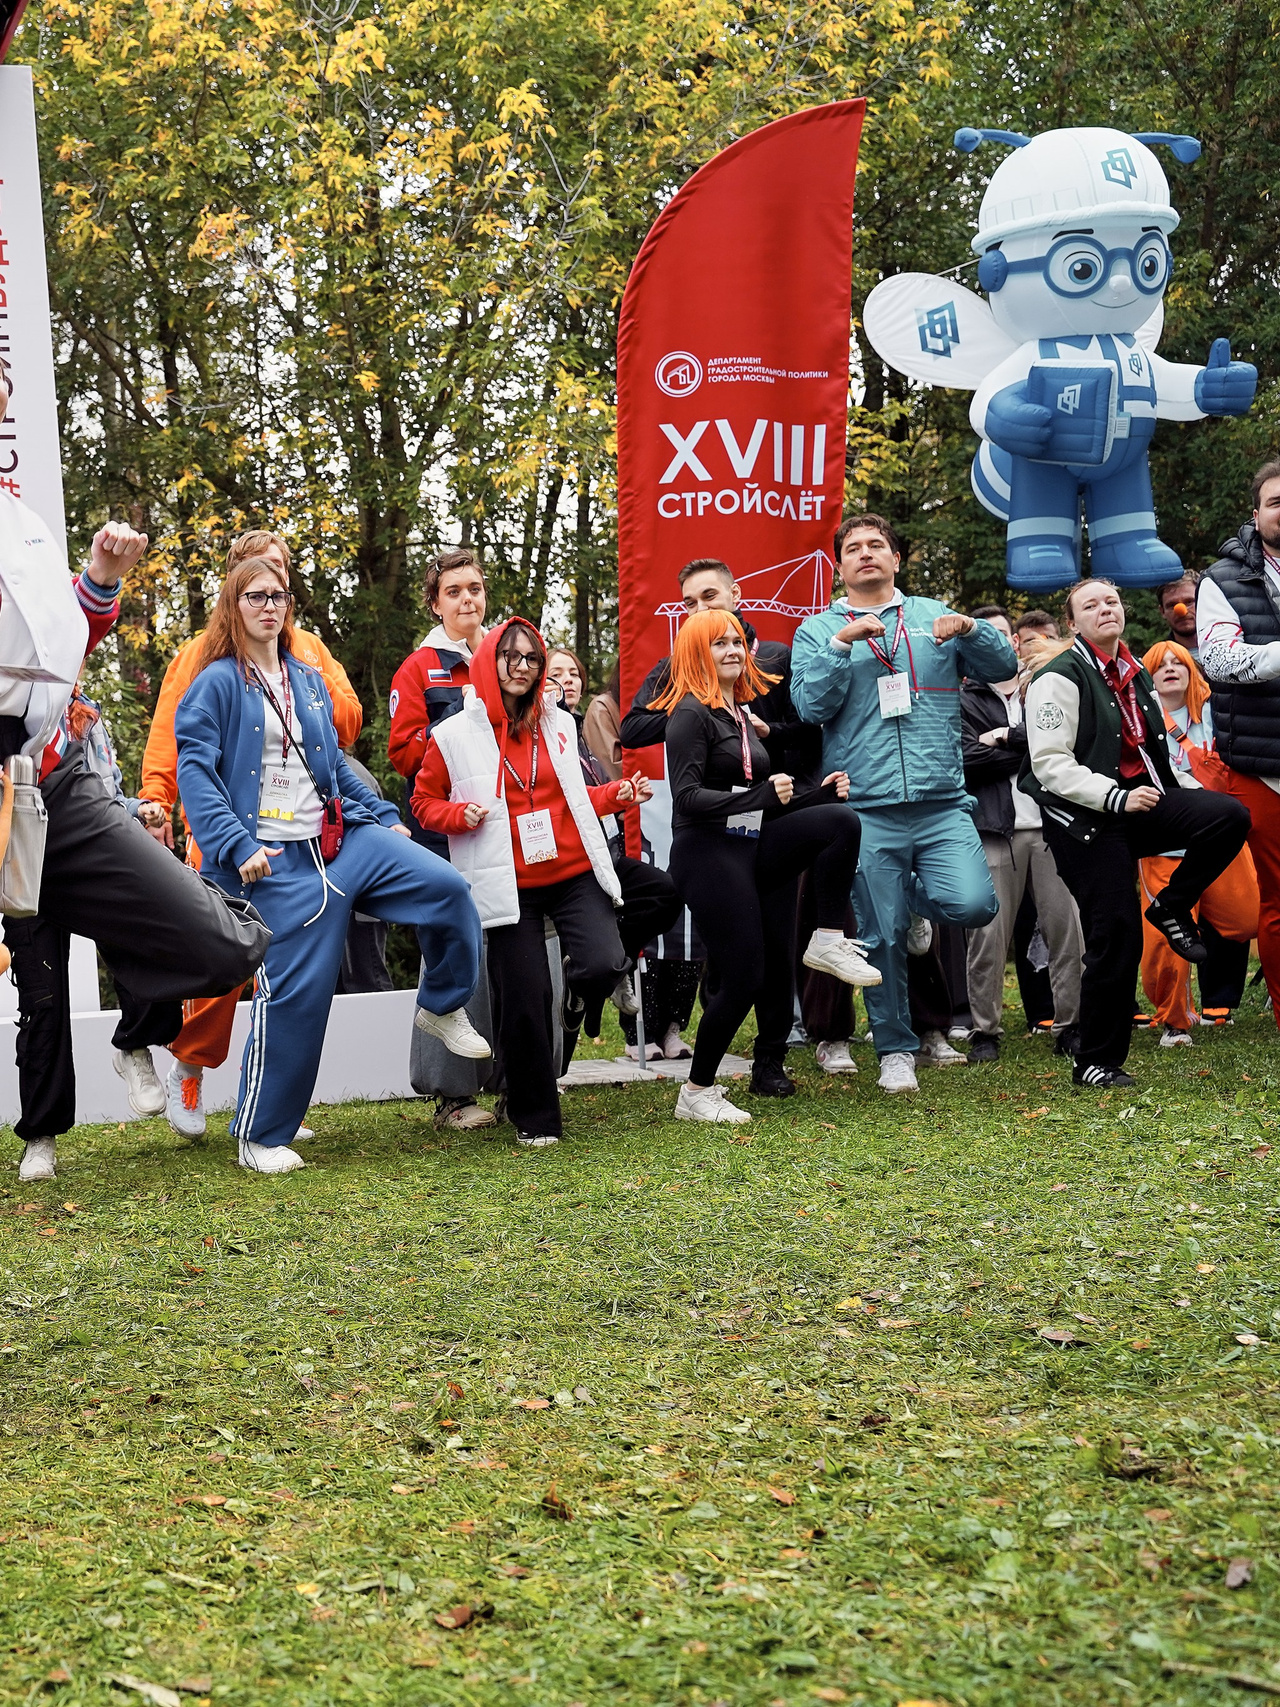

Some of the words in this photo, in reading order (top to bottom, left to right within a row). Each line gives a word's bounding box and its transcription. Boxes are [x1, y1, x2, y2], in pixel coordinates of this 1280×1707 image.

[707, 357, 761, 367] ДЕПАРТАМЕНТ
[707, 365, 787, 378] ГРАДОСТРОИТЕЛЬНОЙ
[787, 370, 829, 379] ПОЛИТИКИ
[708, 375, 742, 383] ГОРОДА
[742, 375, 775, 384] МОСКВЫ
[658, 418, 827, 486] XVIII
[657, 482, 826, 521] СТРОЙСЛЁТ
[272, 777, 290, 786] XVIII
[527, 820, 543, 830] XVIII
